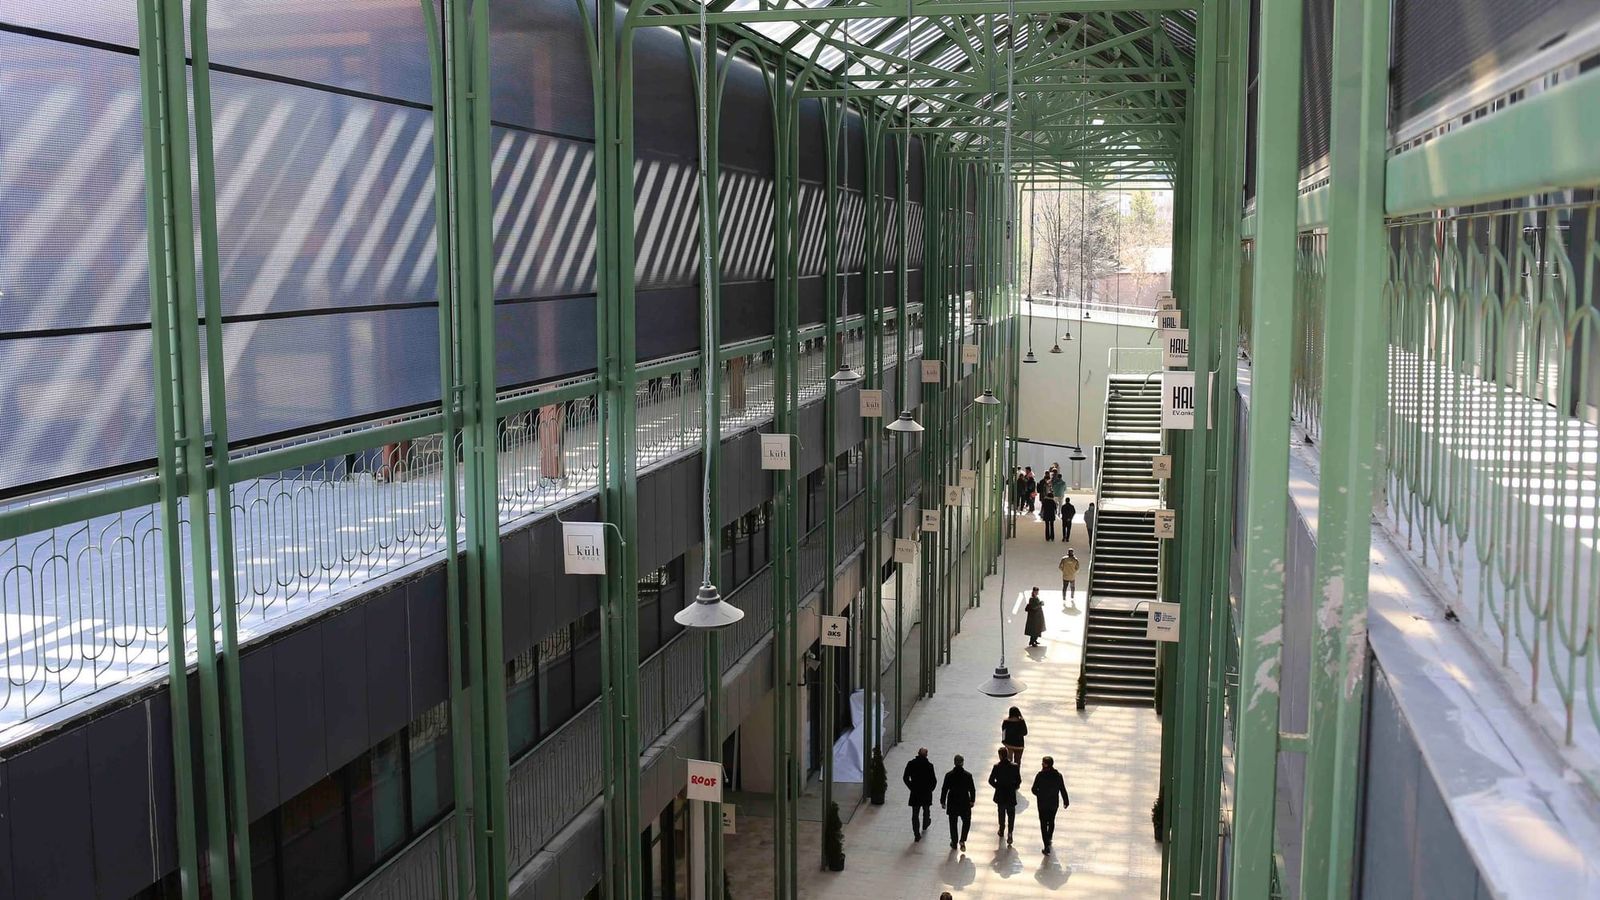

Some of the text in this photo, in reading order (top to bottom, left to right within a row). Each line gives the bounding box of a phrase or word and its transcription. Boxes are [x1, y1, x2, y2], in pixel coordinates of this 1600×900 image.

[1163, 317, 1176, 328] HALL
[1170, 338, 1189, 354] HALL
[1173, 386, 1195, 409] HAL
[769, 450, 787, 458] kült
[576, 545, 600, 556] kült
[691, 775, 717, 787] ROOF
